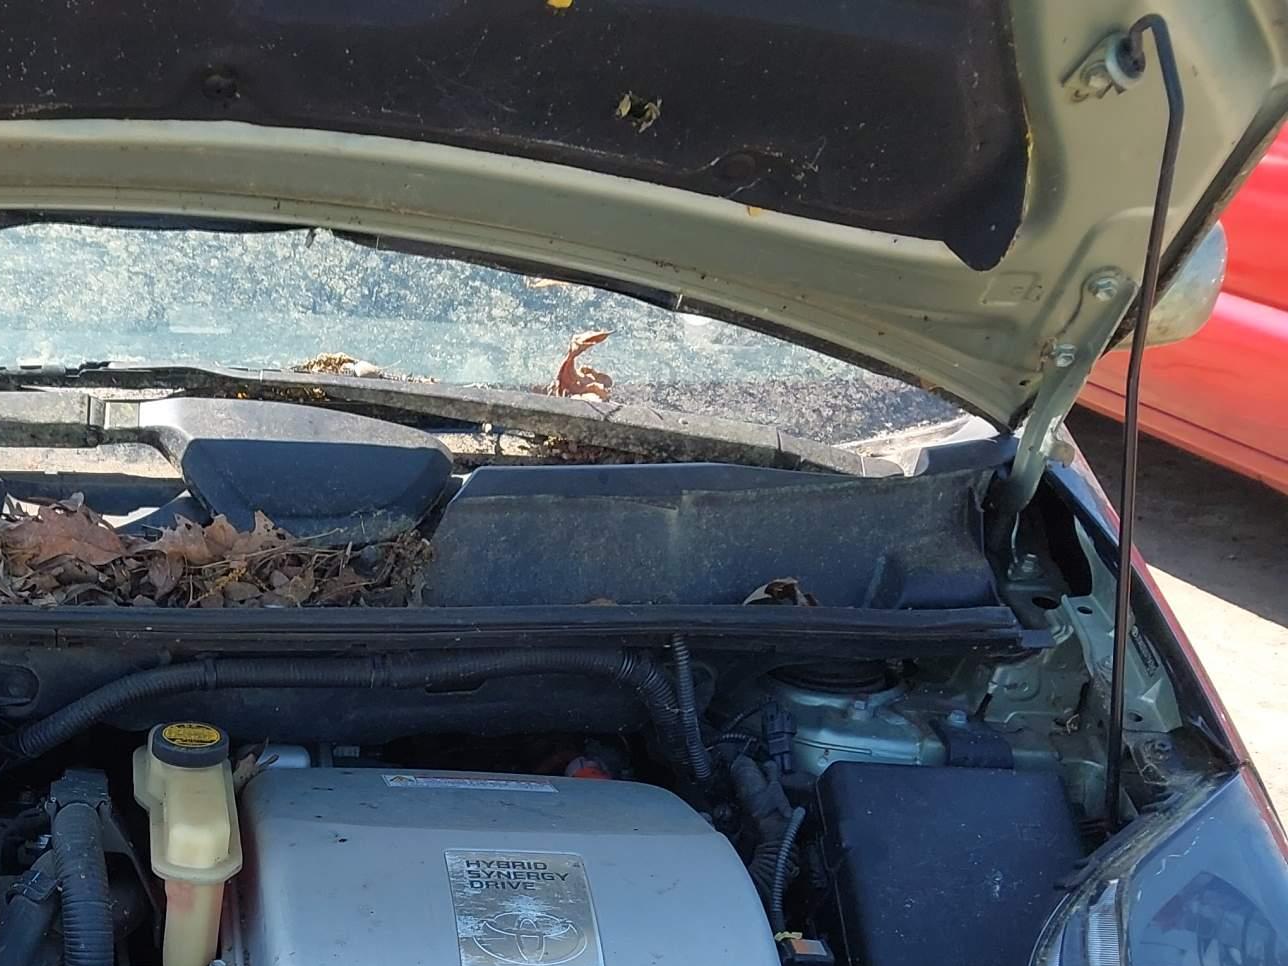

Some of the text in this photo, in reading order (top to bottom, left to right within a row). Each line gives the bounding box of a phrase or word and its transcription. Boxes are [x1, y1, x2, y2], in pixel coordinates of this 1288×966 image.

[466, 860, 548, 870] HYBRID
[467, 870, 569, 881] SYNERGY
[470, 880, 537, 890] DRIVE
